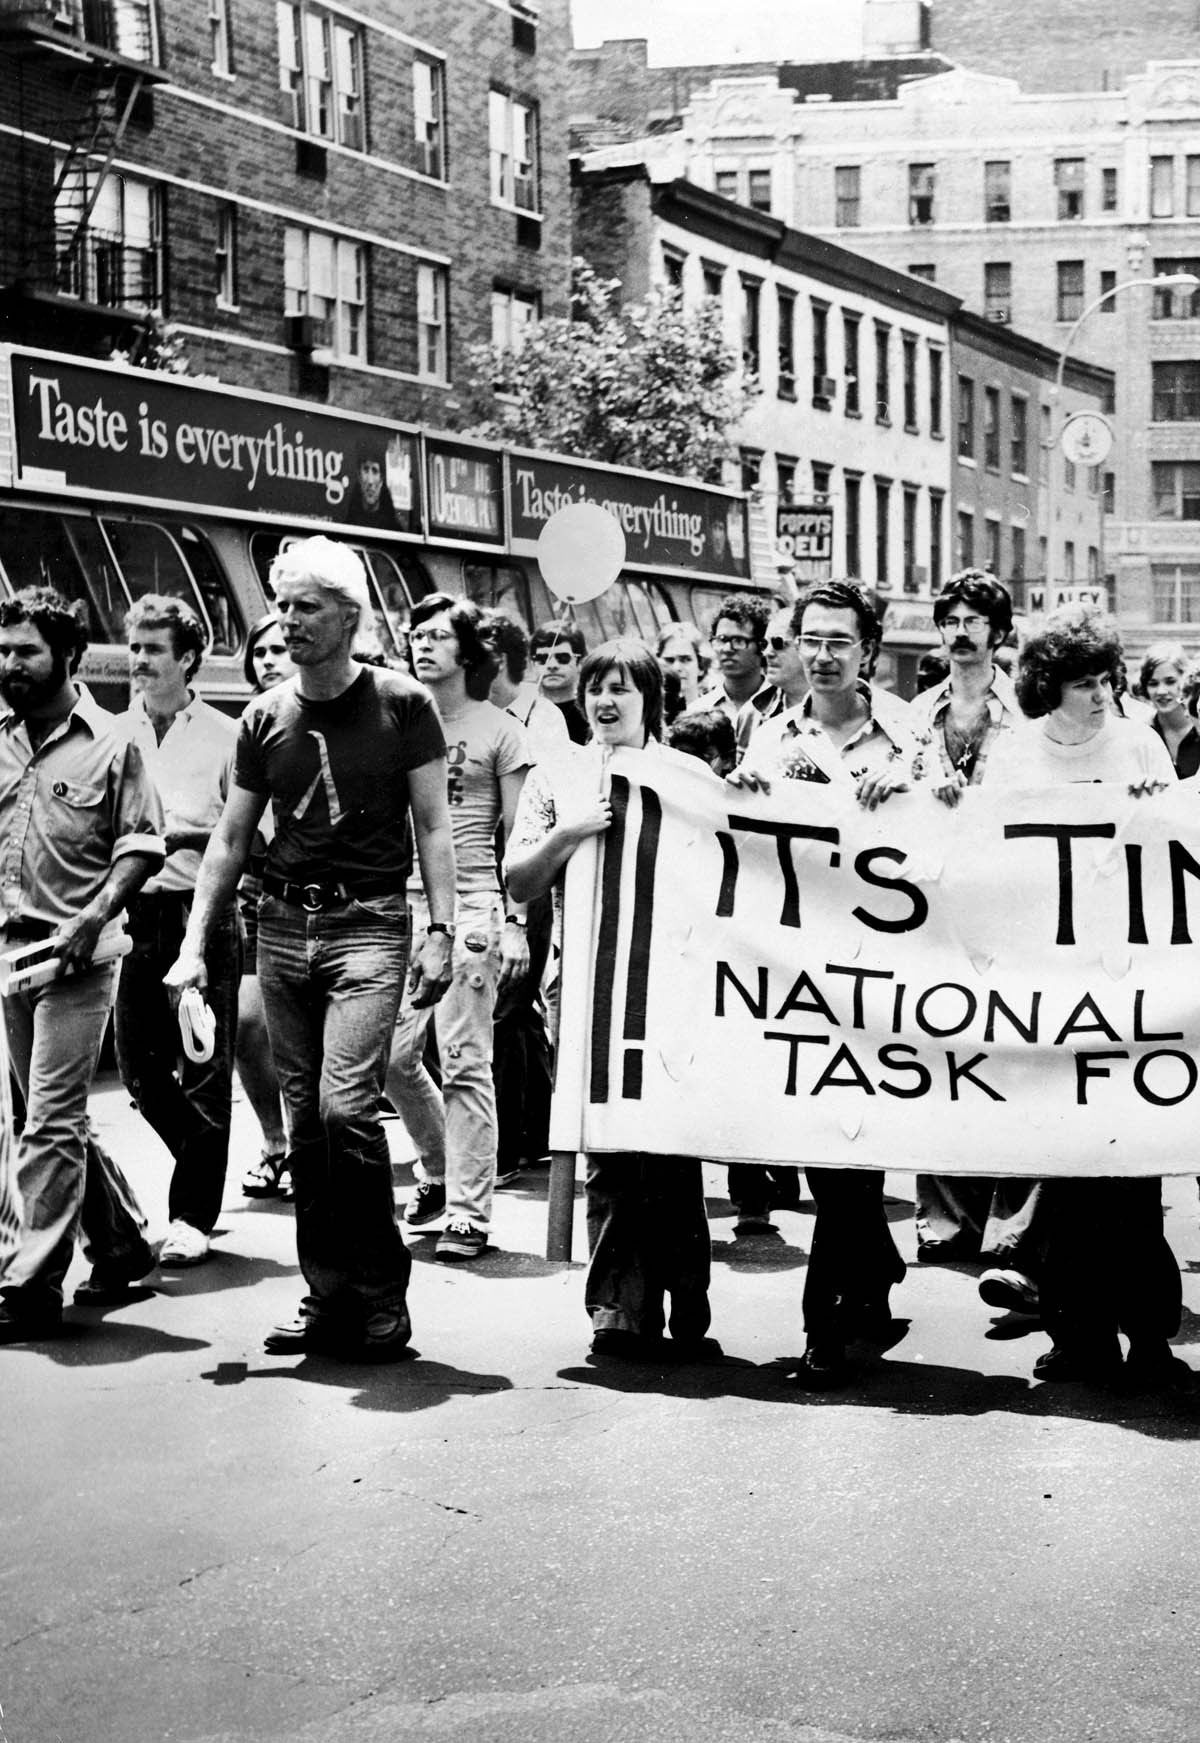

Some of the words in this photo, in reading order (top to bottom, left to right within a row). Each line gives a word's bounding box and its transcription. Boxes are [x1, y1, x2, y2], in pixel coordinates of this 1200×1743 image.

[29, 374, 128, 452] Taste
[139, 401, 168, 459] is
[176, 423, 349, 504] everything.
[777, 535, 830, 557] DELI
[714, 814, 929, 934] IT'S
[714, 961, 1184, 1045] NATIONAL
[763, 1031, 1007, 1101] TASK
